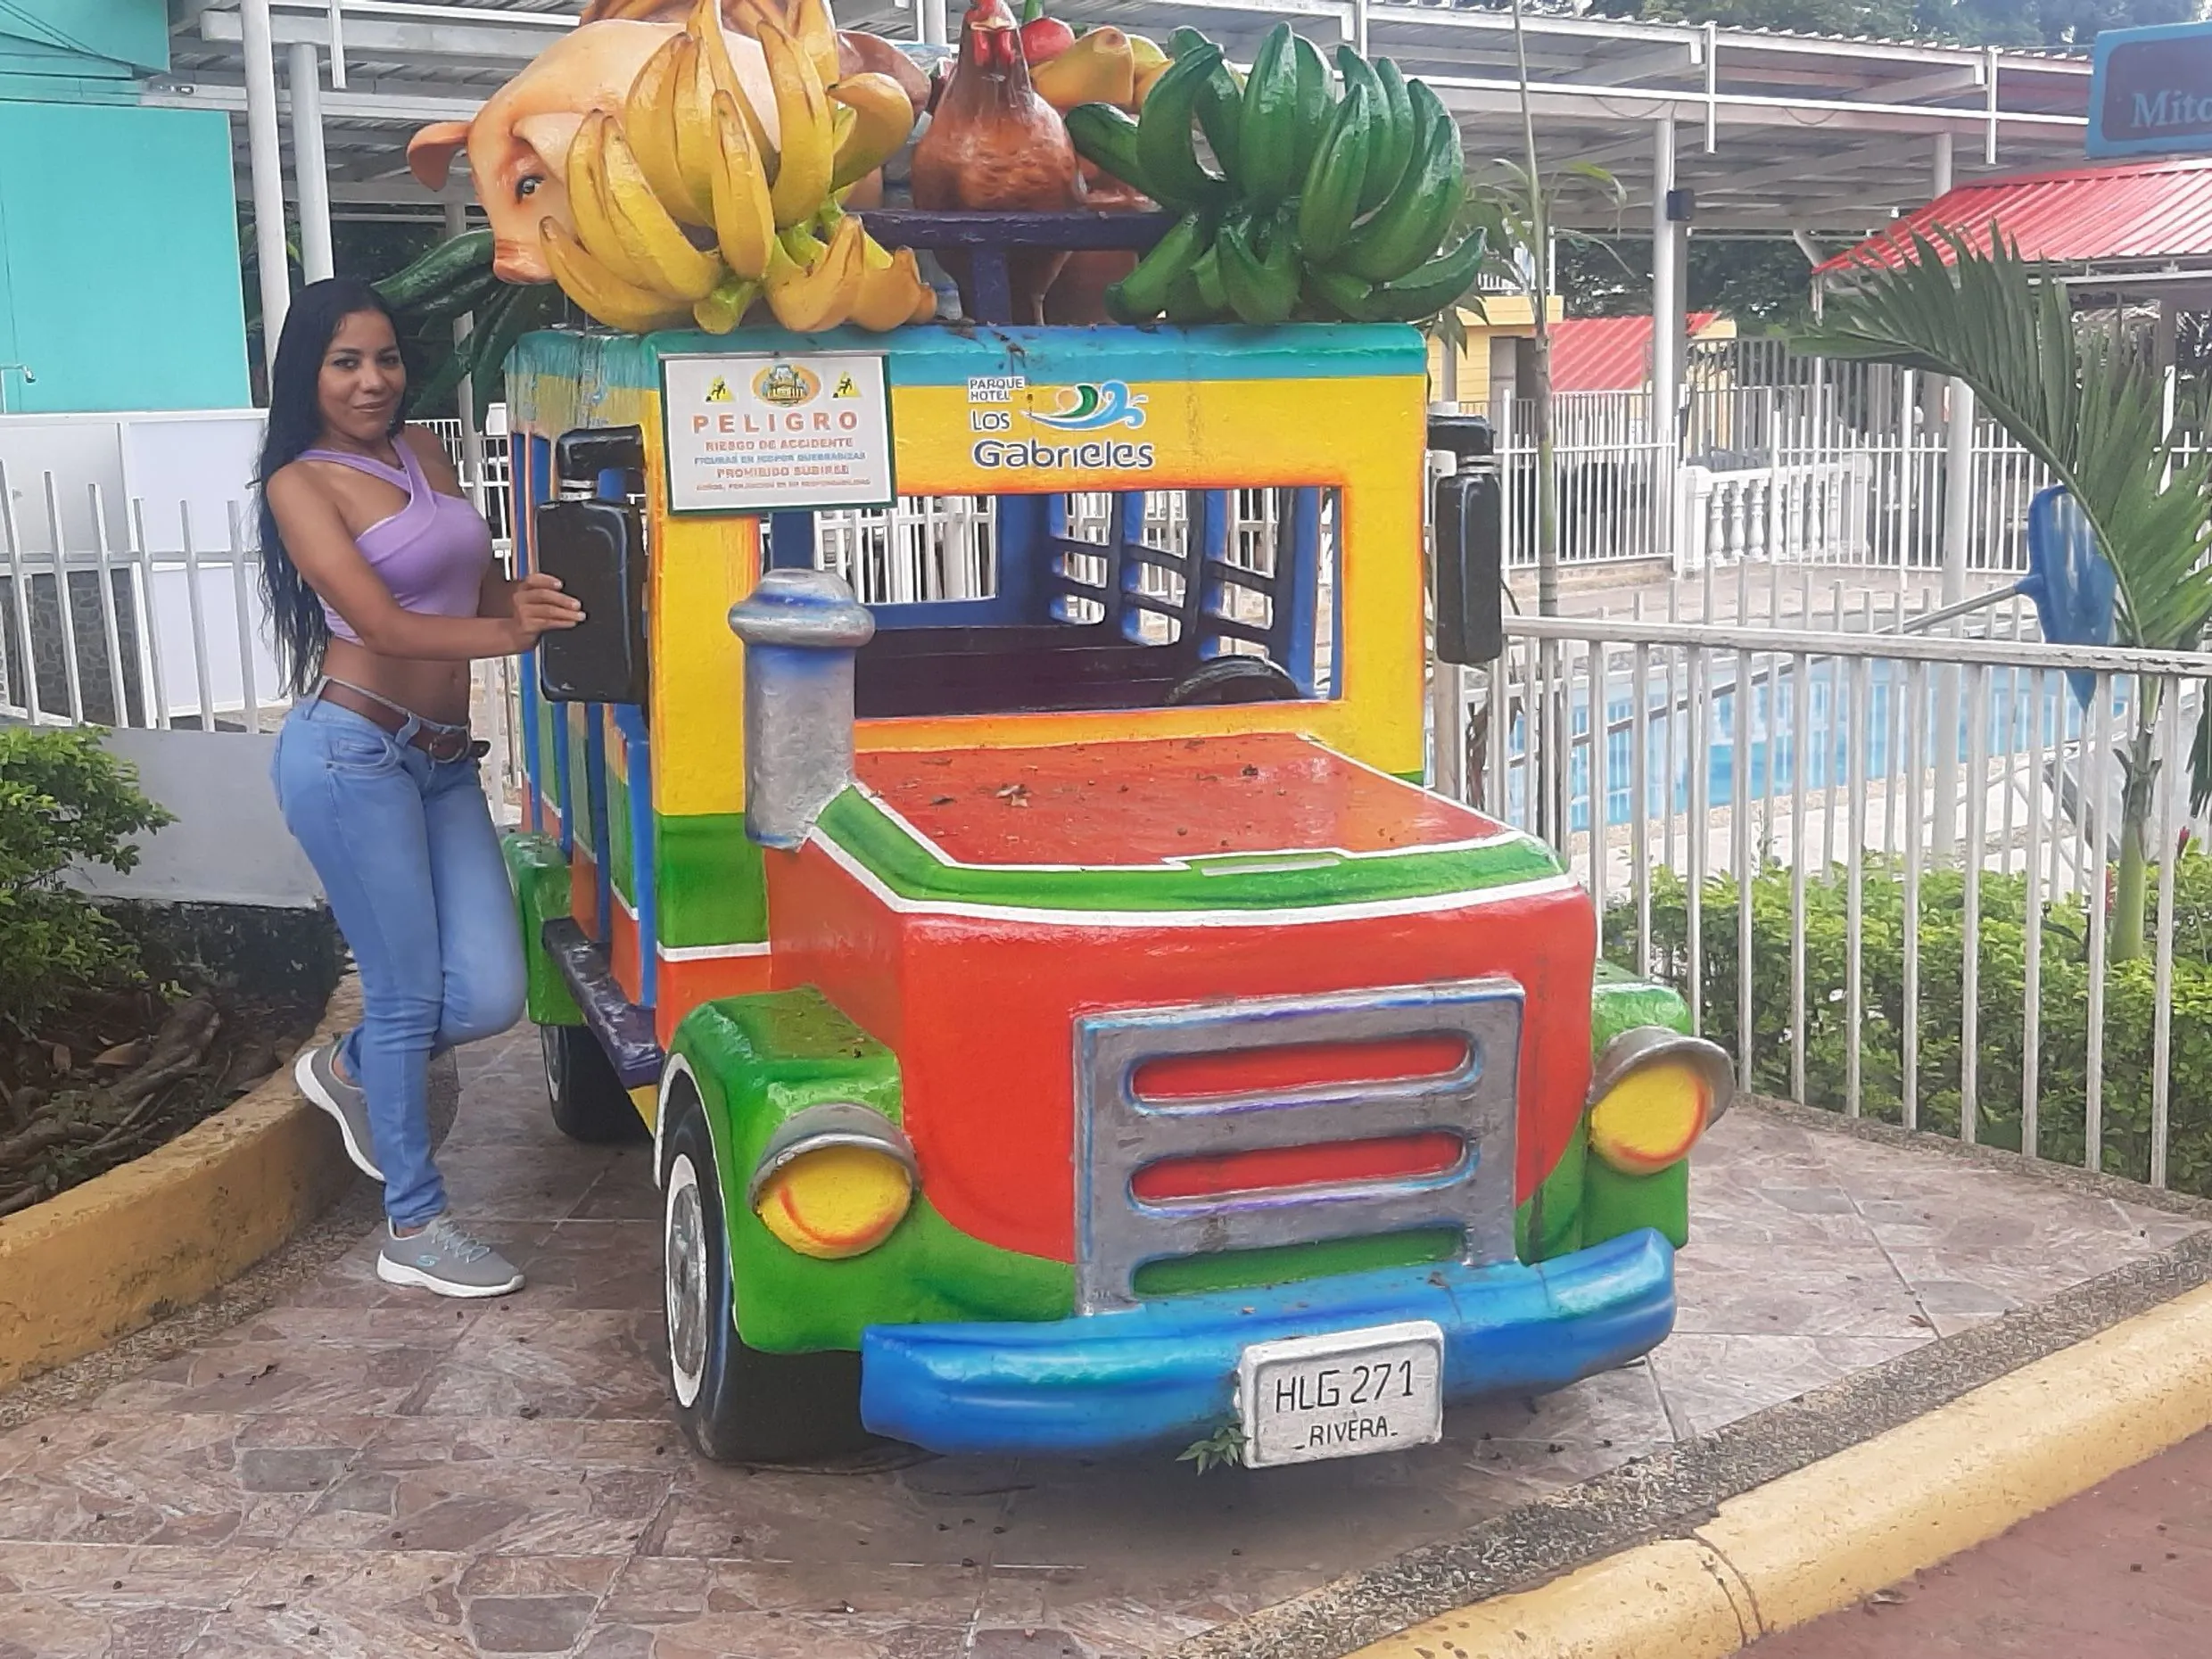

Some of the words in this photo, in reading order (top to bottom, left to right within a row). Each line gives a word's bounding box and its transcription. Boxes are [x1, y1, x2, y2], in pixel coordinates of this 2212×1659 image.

[970, 378, 1024, 390] PARQUE
[970, 391, 1011, 401] HOTEL
[693, 411, 858, 434] PELIGRO
[706, 441, 755, 451] RIESGO
[759, 440, 776, 450] DE
[780, 438, 853, 450] ACCIDENTE
[974, 438, 1153, 468] Gabrieles
[1275, 1369, 1341, 1414] HLG
[1349, 1359, 1414, 1405] 271
